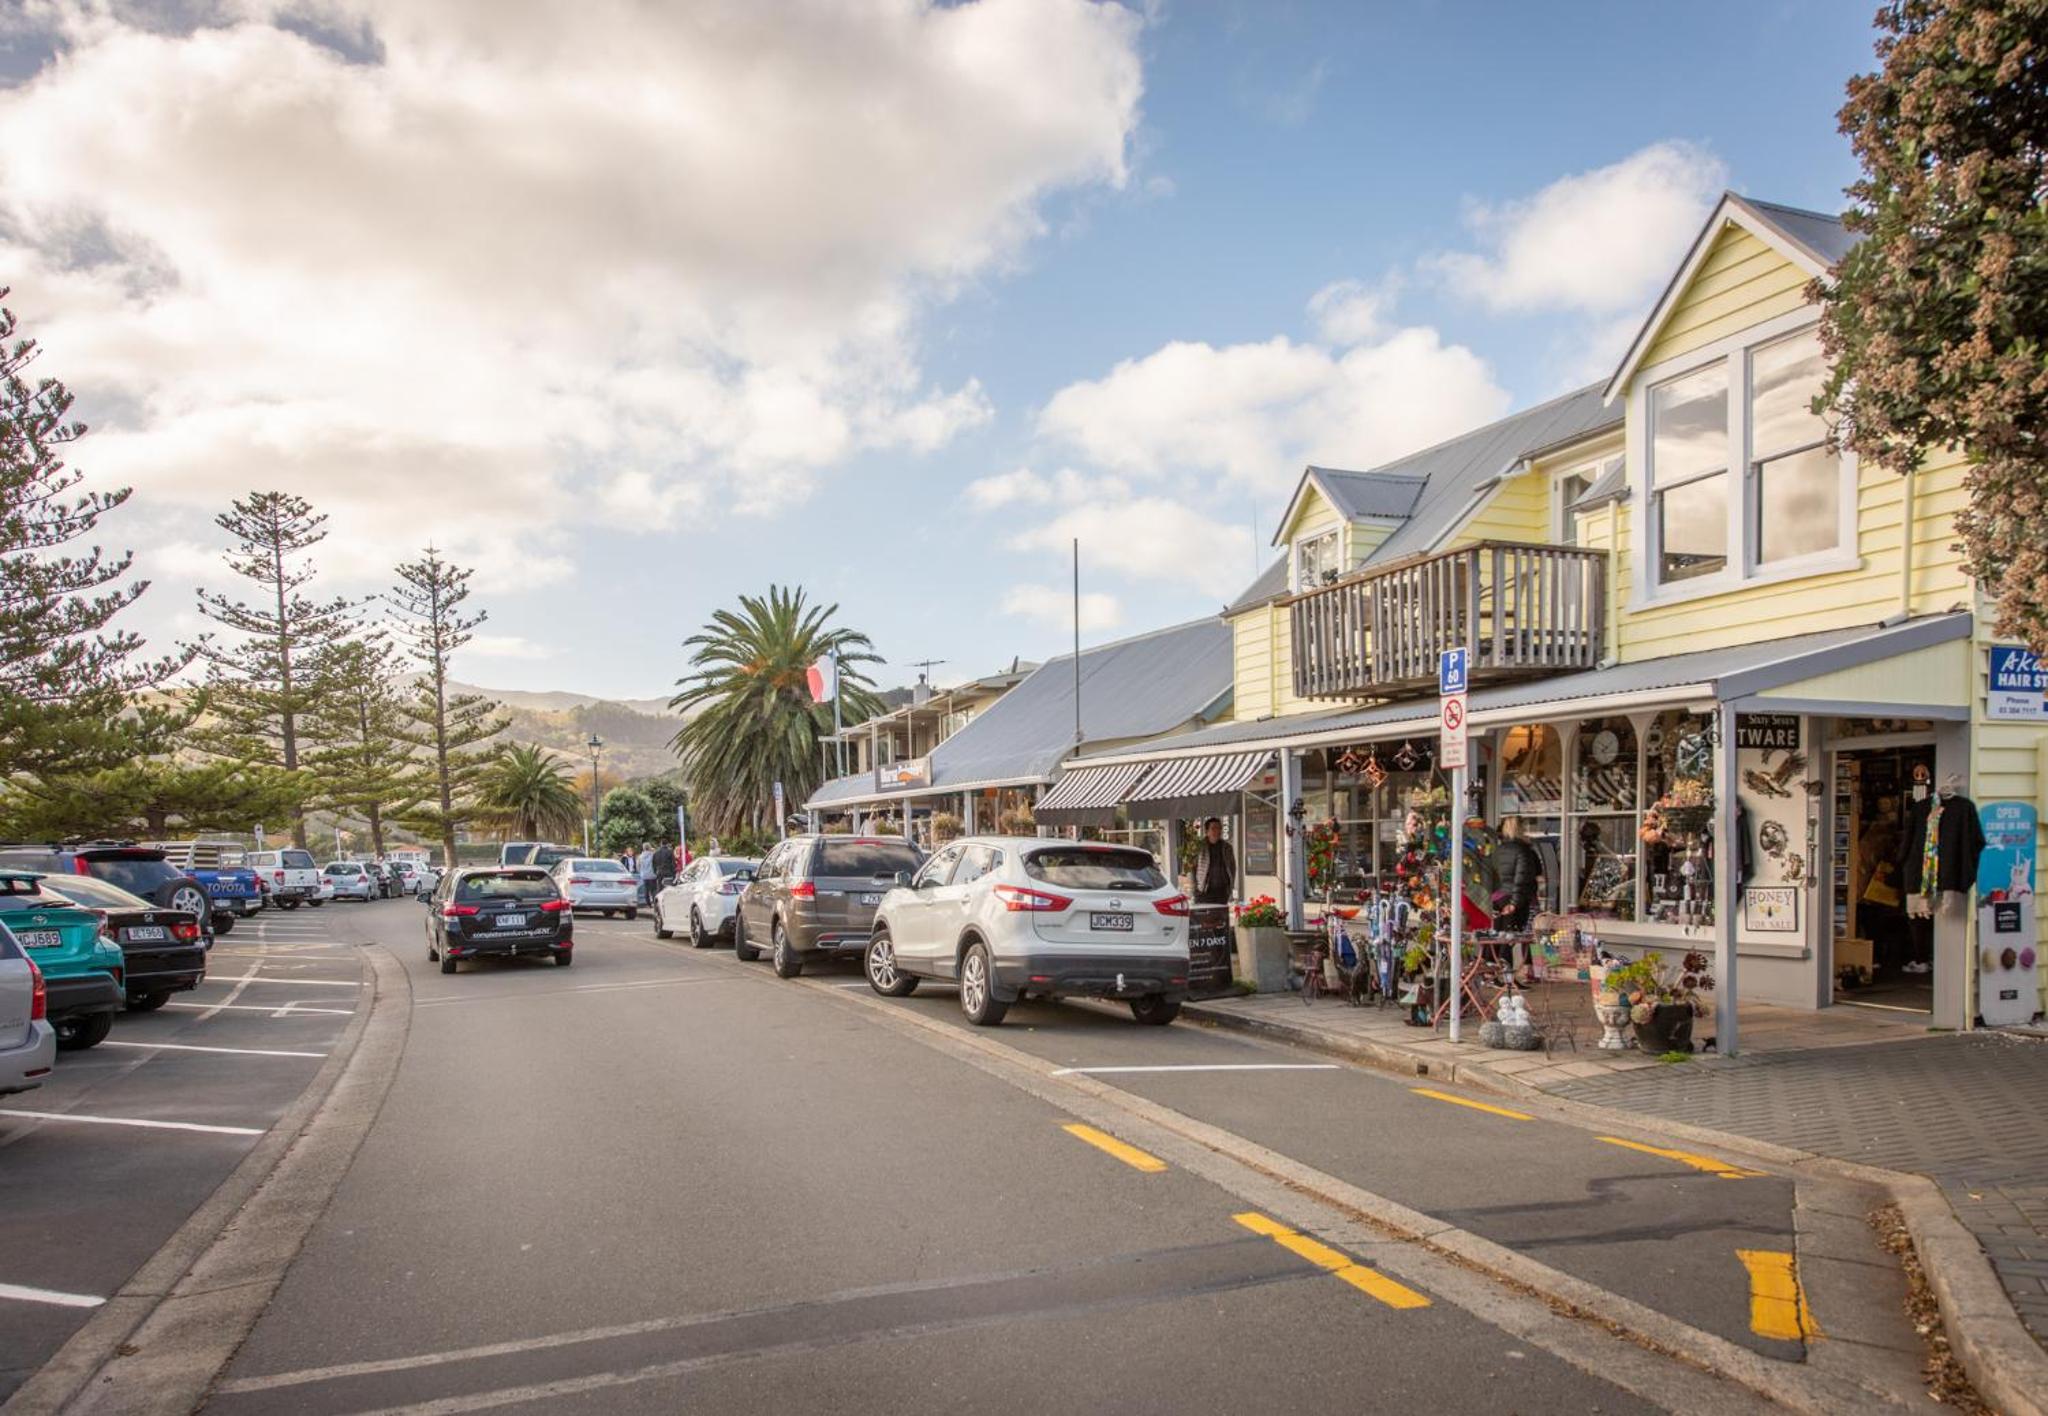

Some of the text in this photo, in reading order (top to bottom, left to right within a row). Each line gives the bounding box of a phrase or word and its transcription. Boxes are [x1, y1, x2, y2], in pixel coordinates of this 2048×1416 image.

[1449, 653, 1459, 669] P
[1447, 669, 1459, 684] 60
[1998, 673, 2032, 688] HAIR
[1737, 728, 1796, 746] TWARE
[207, 882, 246, 894] TOYOTA
[1748, 891, 1793, 906] HONEY
[1207, 936, 1227, 947] DAYS
